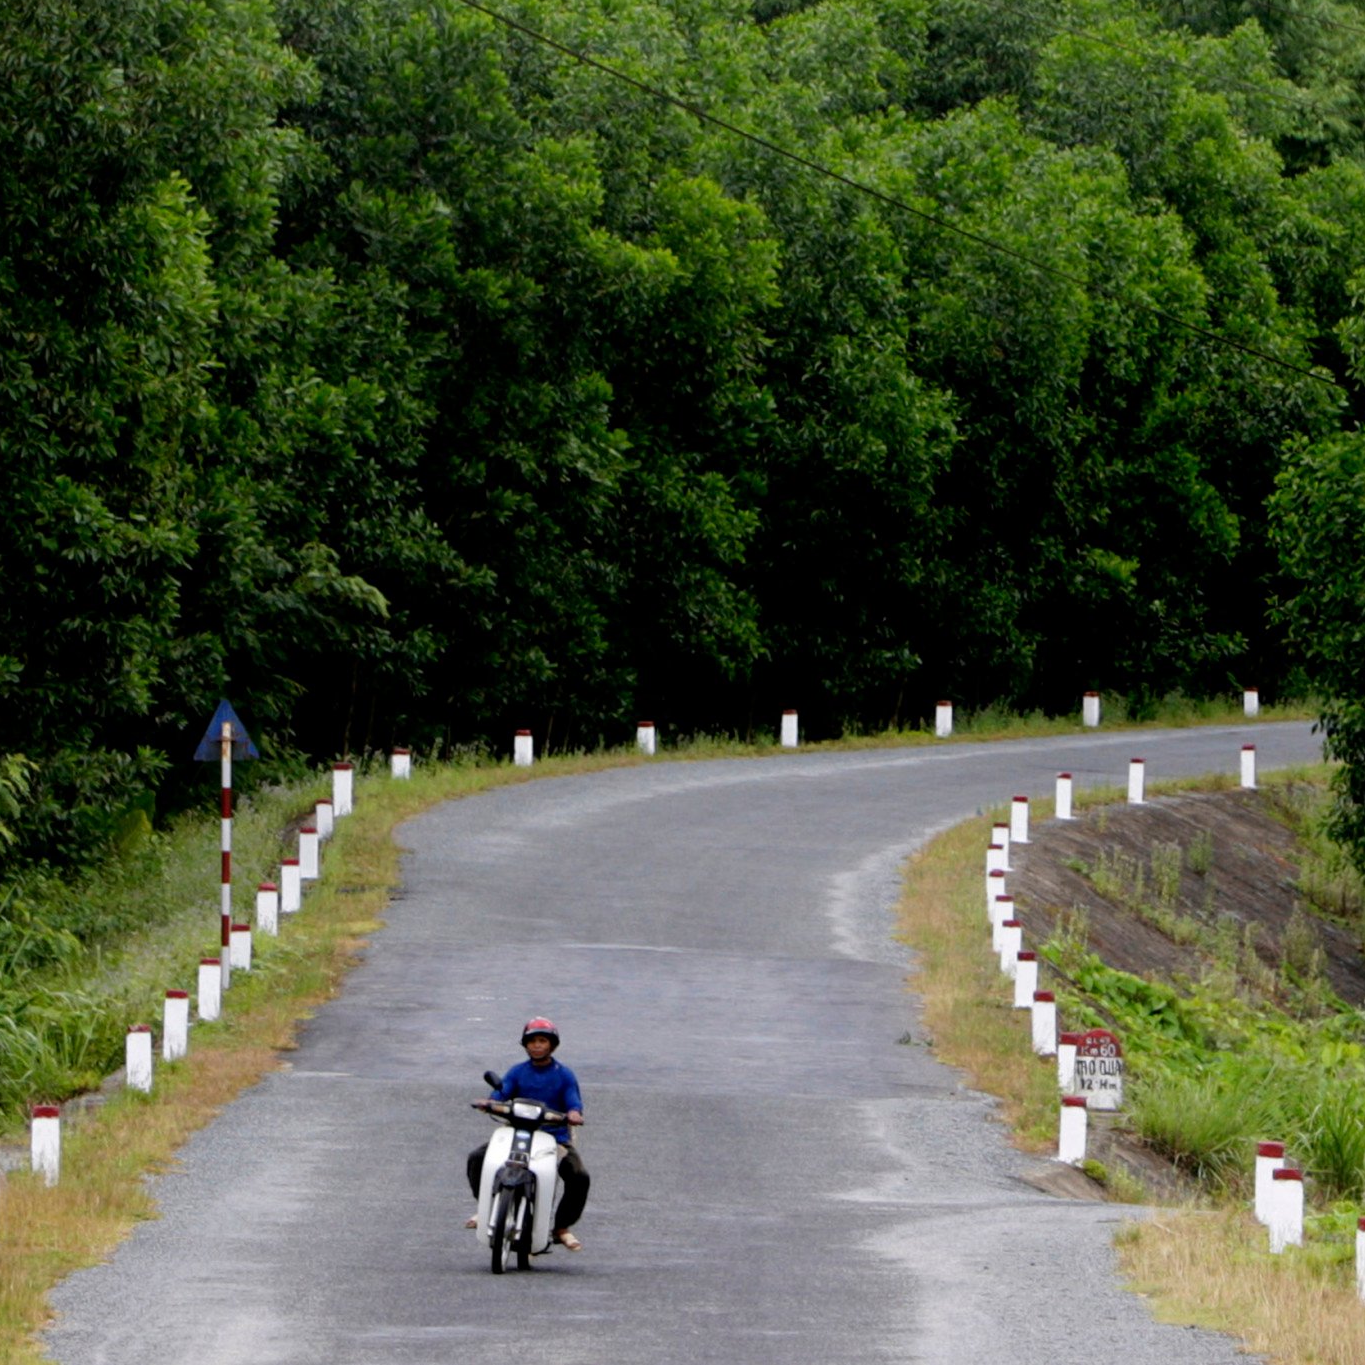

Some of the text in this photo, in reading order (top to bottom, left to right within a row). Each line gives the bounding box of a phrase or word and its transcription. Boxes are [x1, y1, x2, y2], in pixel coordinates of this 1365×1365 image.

[1081, 1043, 1116, 1057] Km 60
[1080, 1078, 1093, 1090] 12
